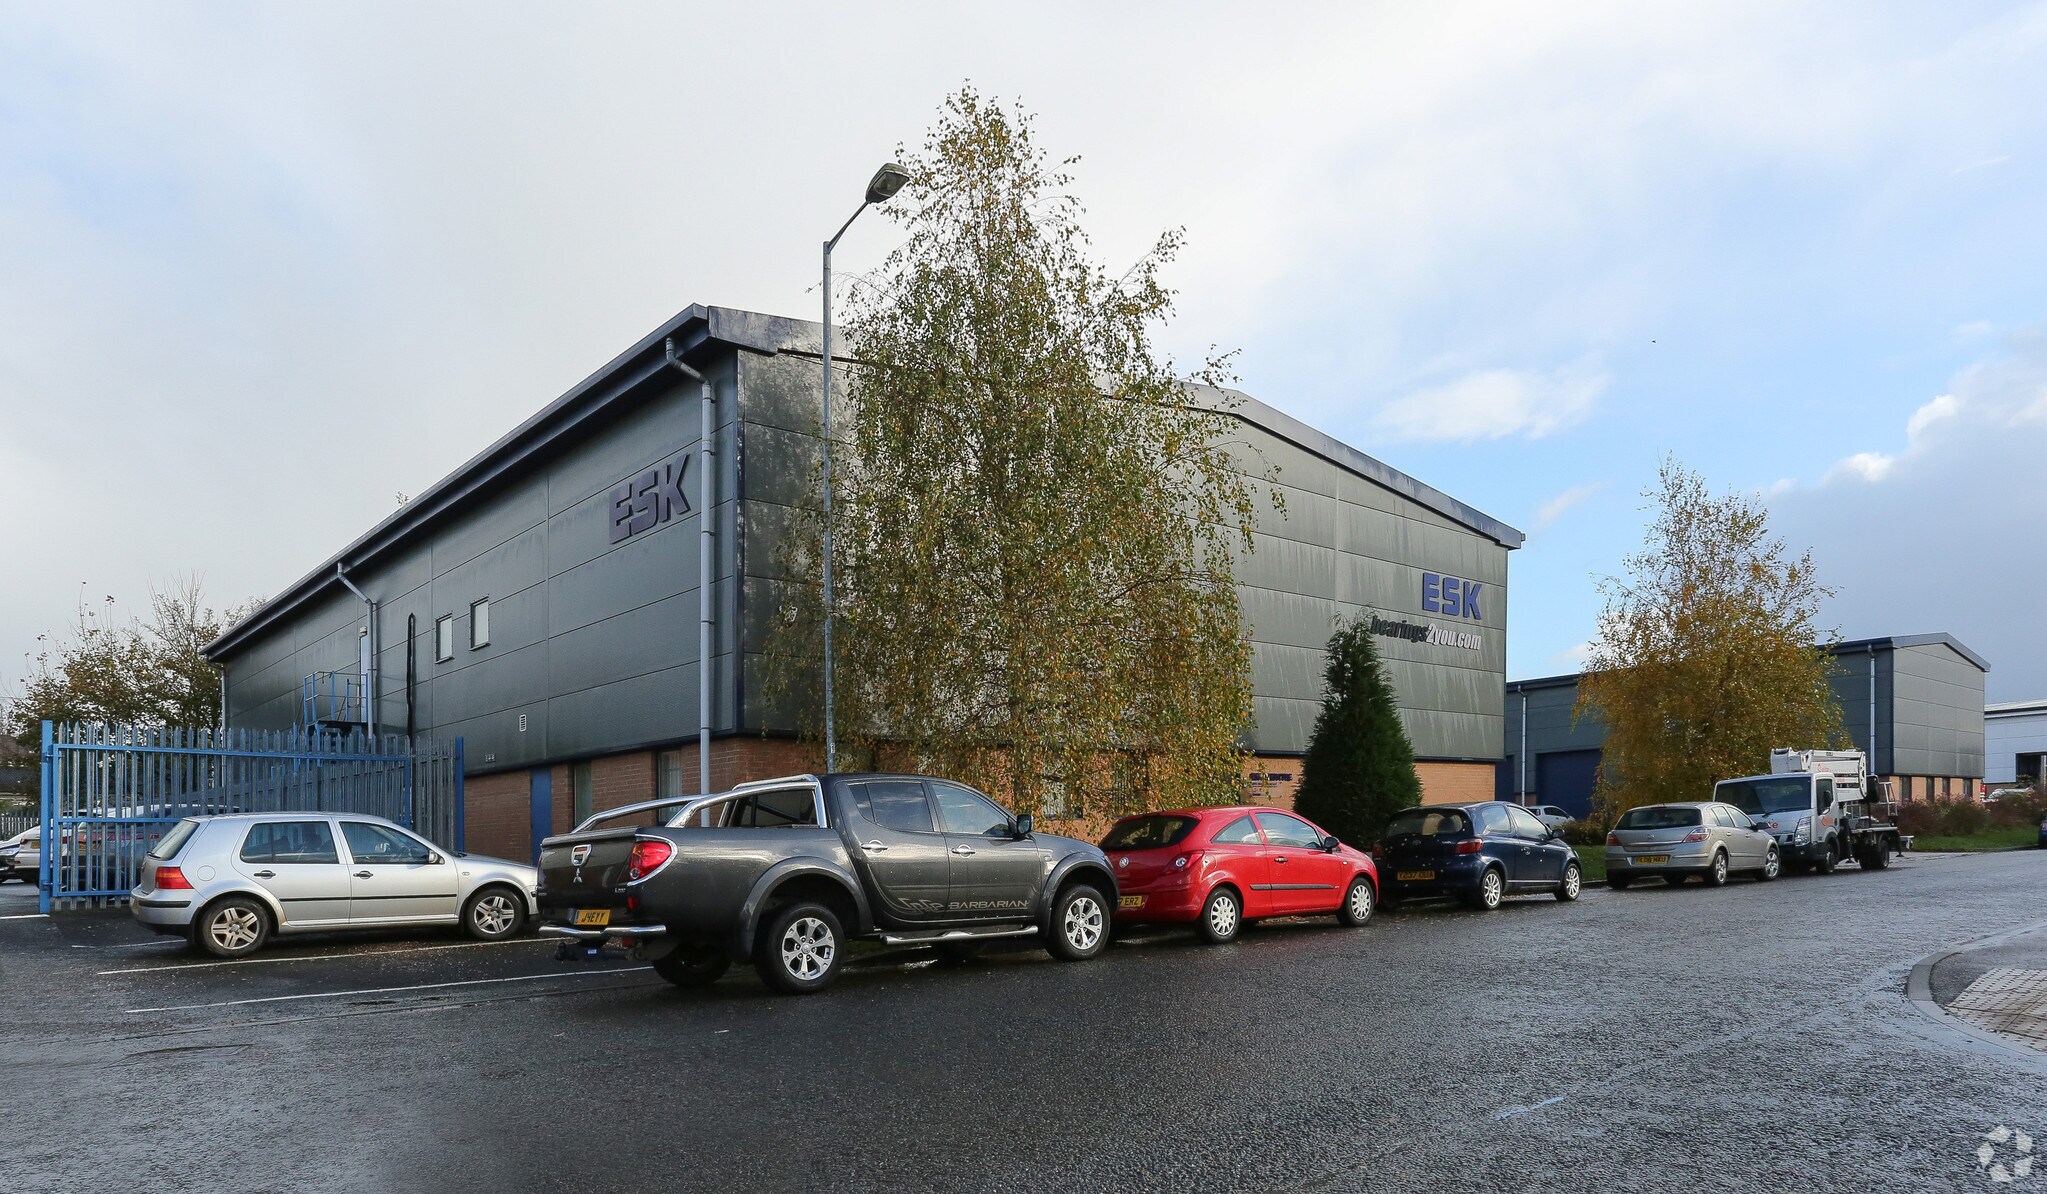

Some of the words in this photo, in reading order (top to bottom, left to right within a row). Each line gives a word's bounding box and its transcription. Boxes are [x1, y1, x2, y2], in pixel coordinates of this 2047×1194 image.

[608, 453, 690, 545] ESK
[1422, 572, 1482, 620] ESK
[1370, 615, 1482, 650] bearings2you.com
[950, 900, 1027, 909] BARBARIAN
[1125, 896, 1139, 905] ERZ
